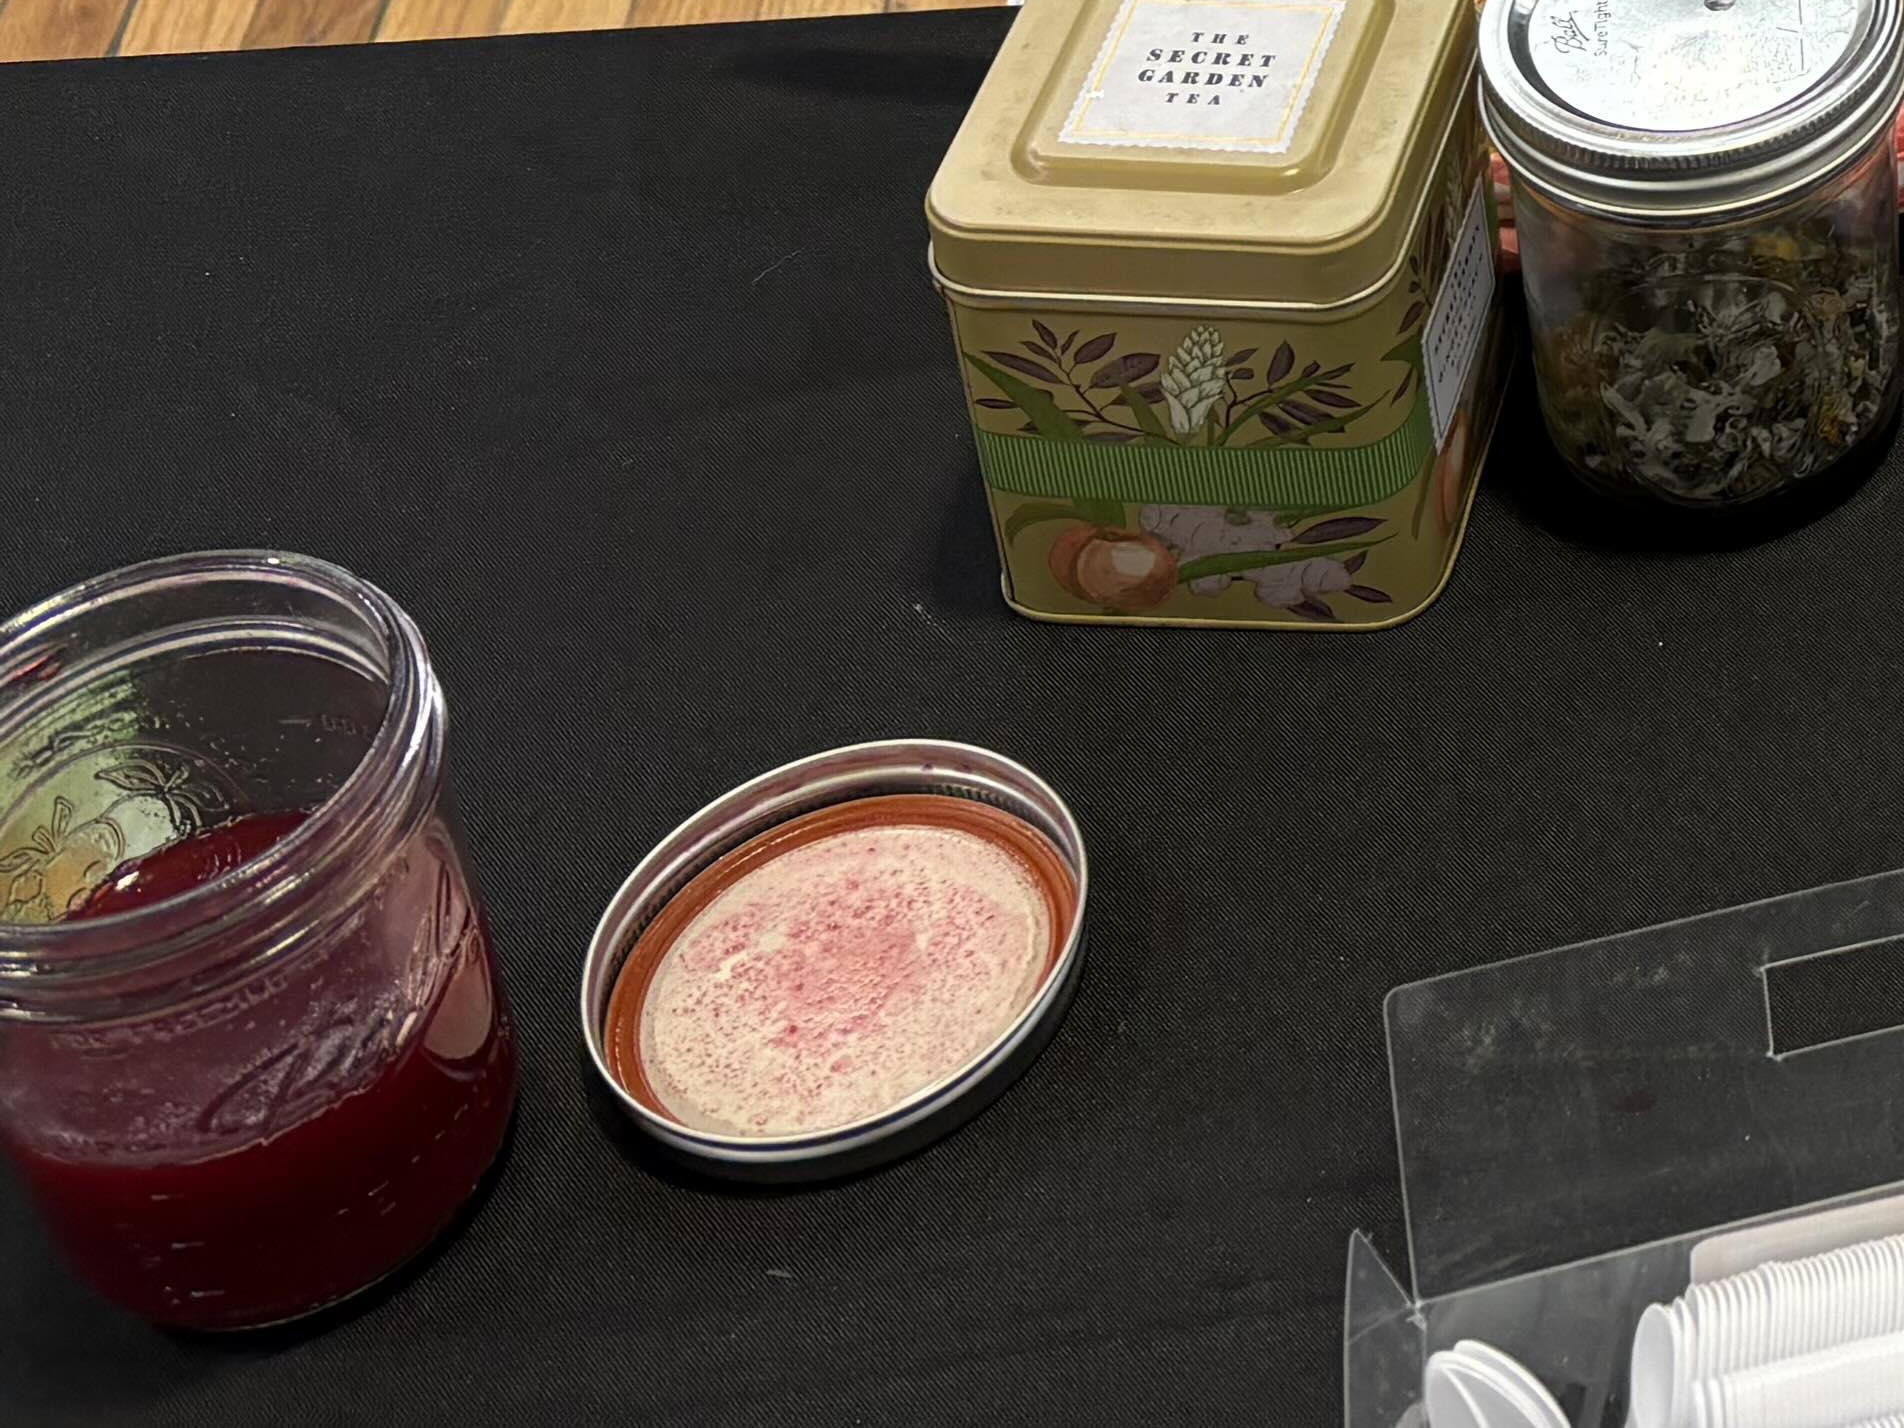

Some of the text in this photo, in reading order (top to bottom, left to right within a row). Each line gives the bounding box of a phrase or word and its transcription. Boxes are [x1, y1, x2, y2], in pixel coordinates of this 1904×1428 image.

[1191, 31, 1250, 46] THE
[1145, 48, 1277, 69] SECRET
[1137, 68, 1269, 89] GARDEN
[1165, 92, 1222, 106] TEA
